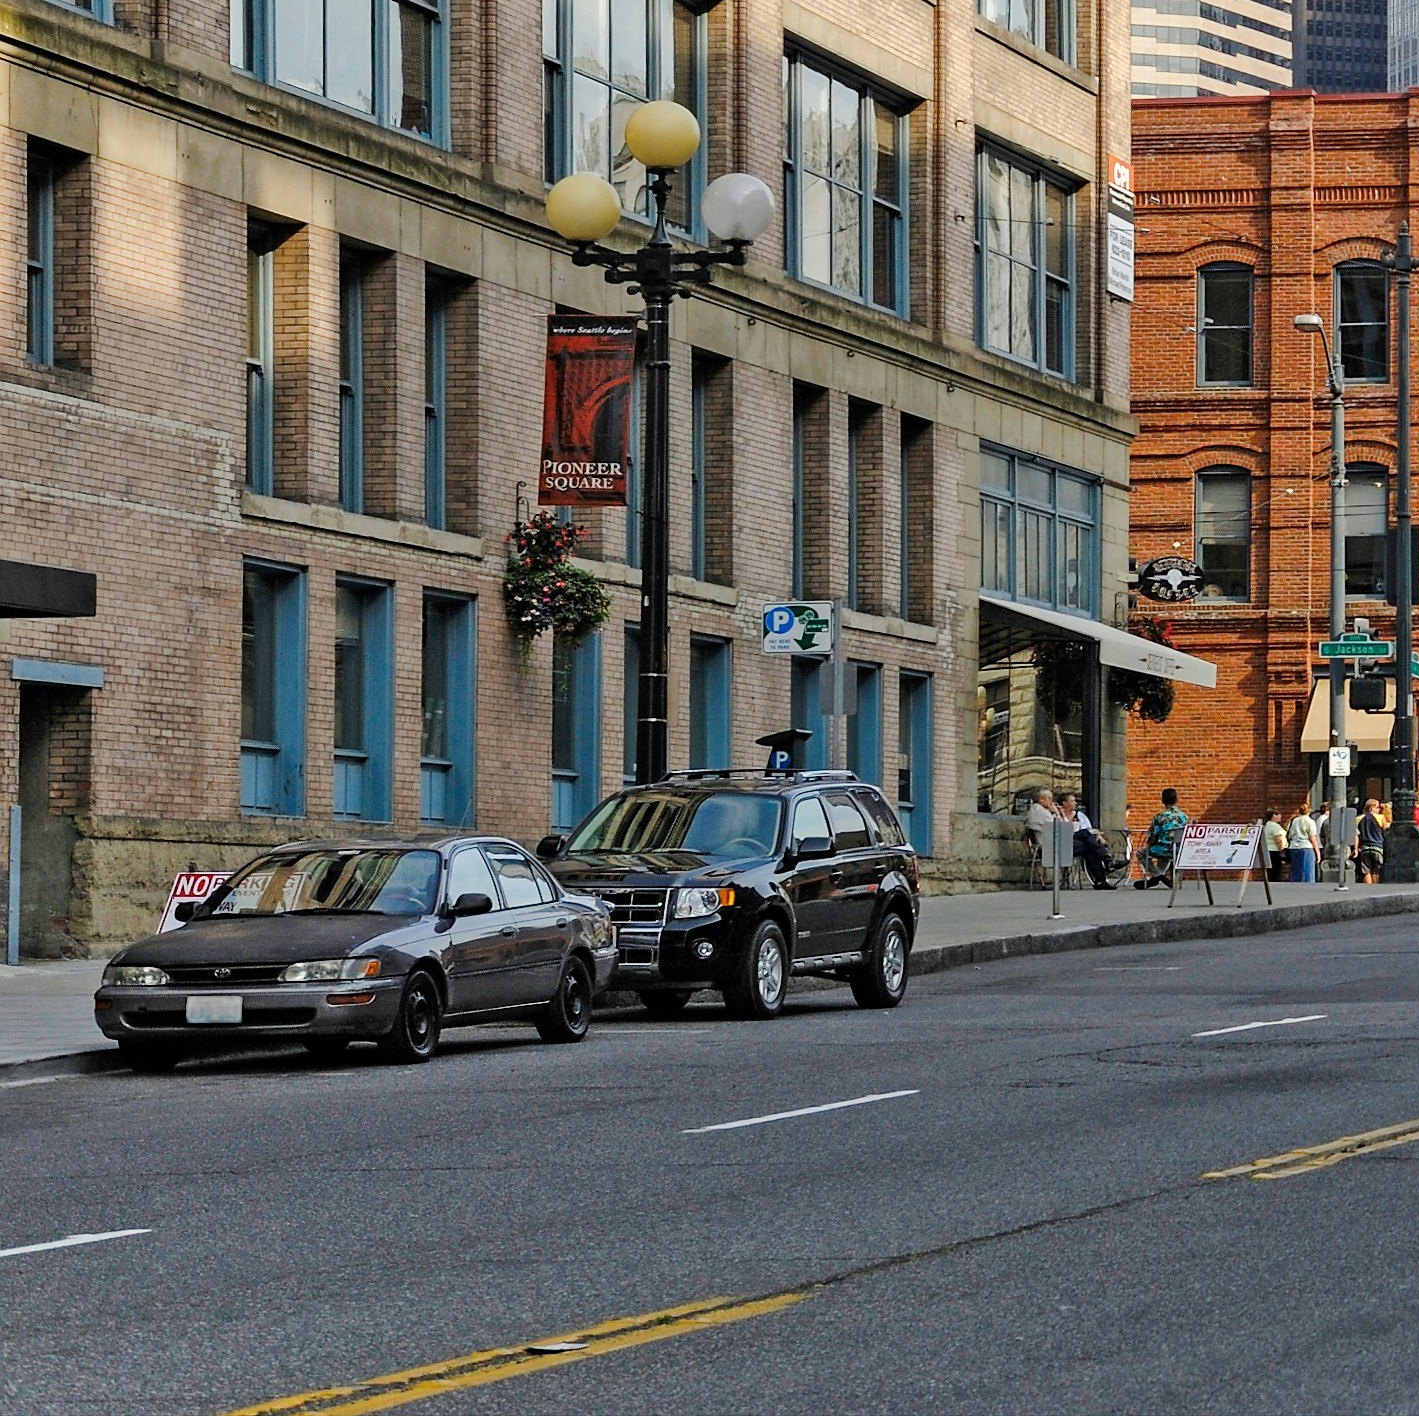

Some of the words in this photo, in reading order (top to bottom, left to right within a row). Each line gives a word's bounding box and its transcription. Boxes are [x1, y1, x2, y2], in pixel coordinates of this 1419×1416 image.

[1113, 161, 1131, 190] CPI
[576, 325, 605, 334] Seattle
[605, 325, 633, 336] begins
[543, 458, 623, 476] PIONEER
[545, 476, 615, 492] SQUARE
[773, 611, 790, 632] P
[1335, 645, 1374, 654] Jackson
[776, 751, 789, 769] P
[1186, 826, 1206, 838] NO
[175, 875, 212, 896] NO
